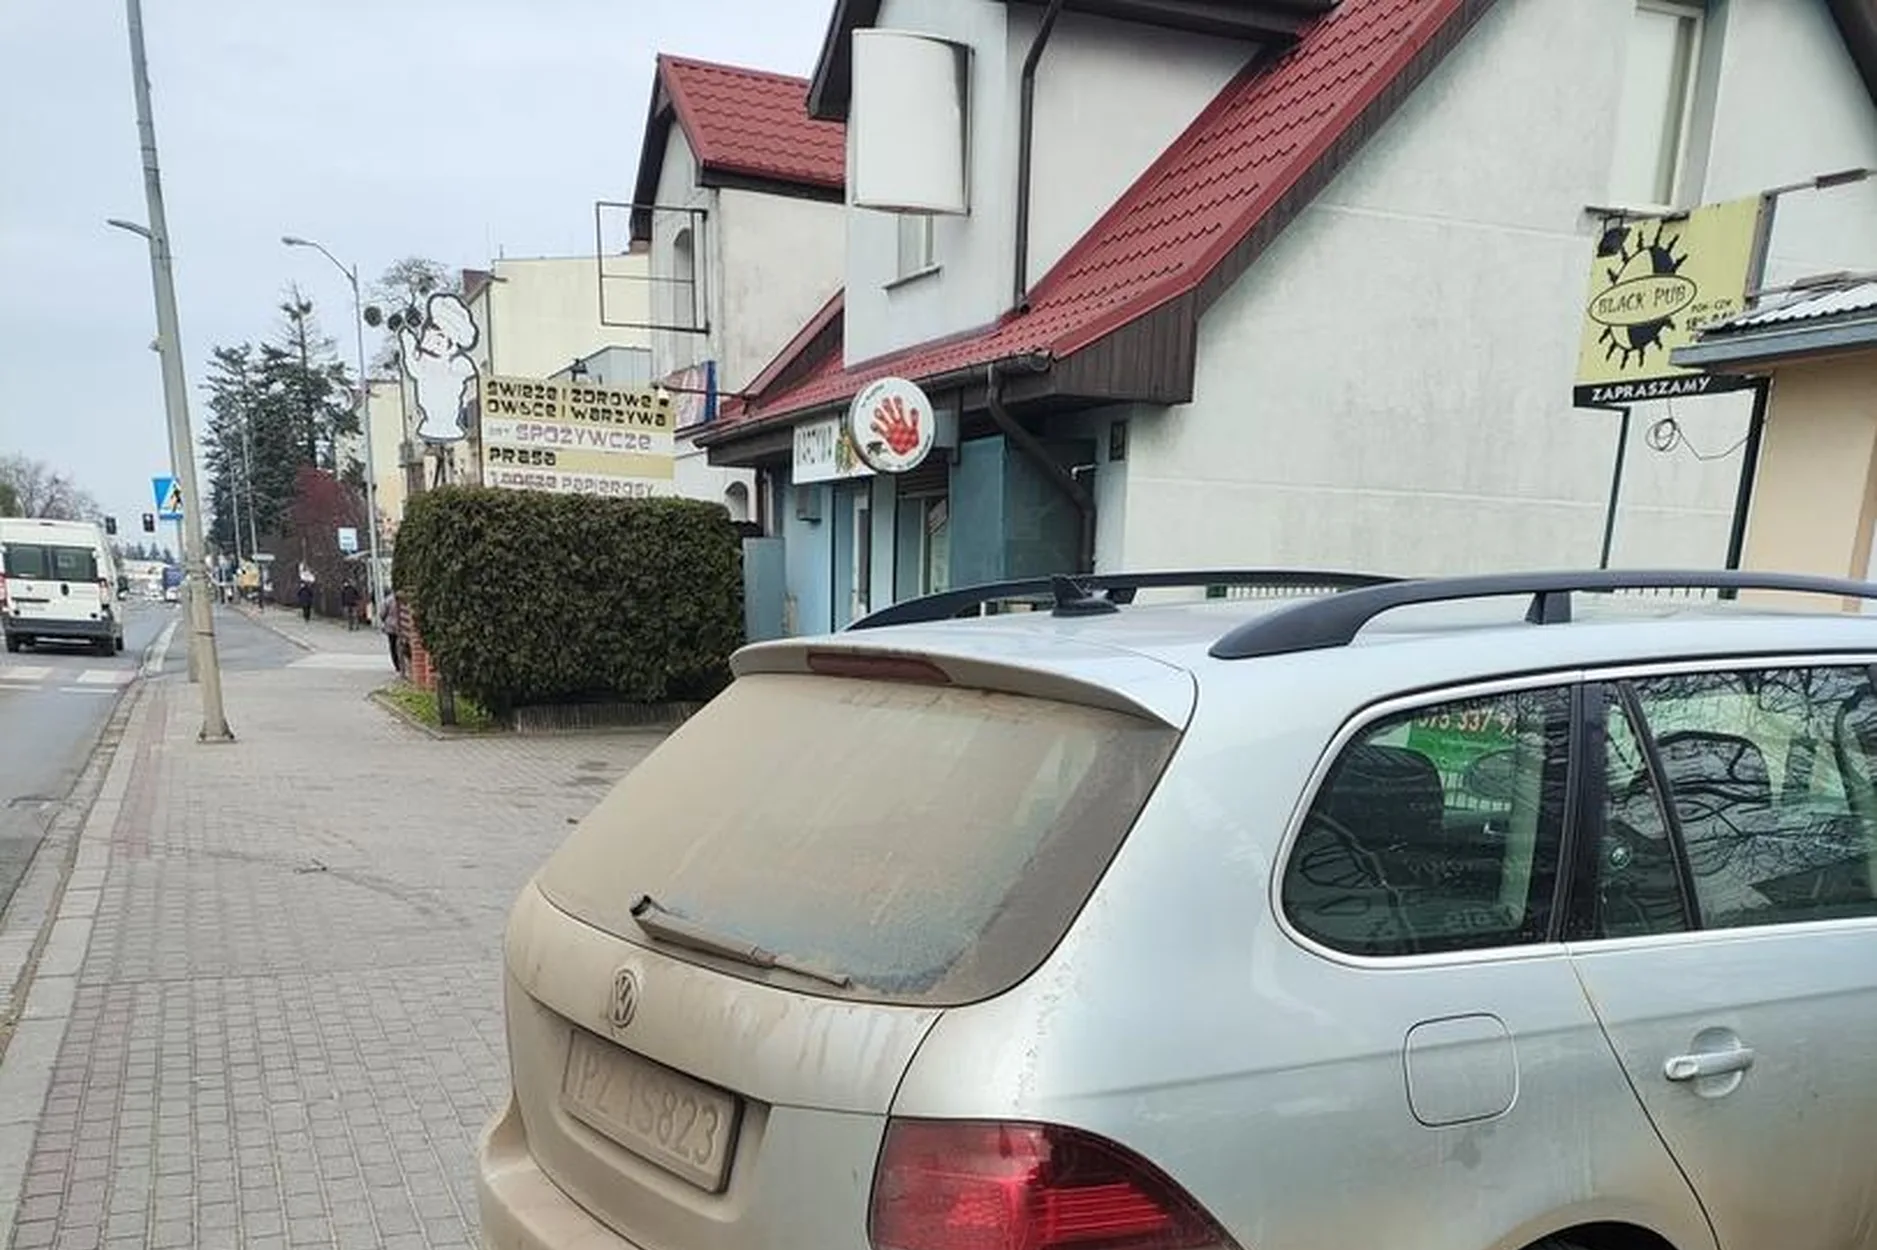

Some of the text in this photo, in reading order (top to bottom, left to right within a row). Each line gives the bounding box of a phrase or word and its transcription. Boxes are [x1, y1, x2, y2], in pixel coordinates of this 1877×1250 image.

[1598, 284, 1686, 314] BLACK PUB
[1591, 376, 1711, 401] ZAPRASZAMY
